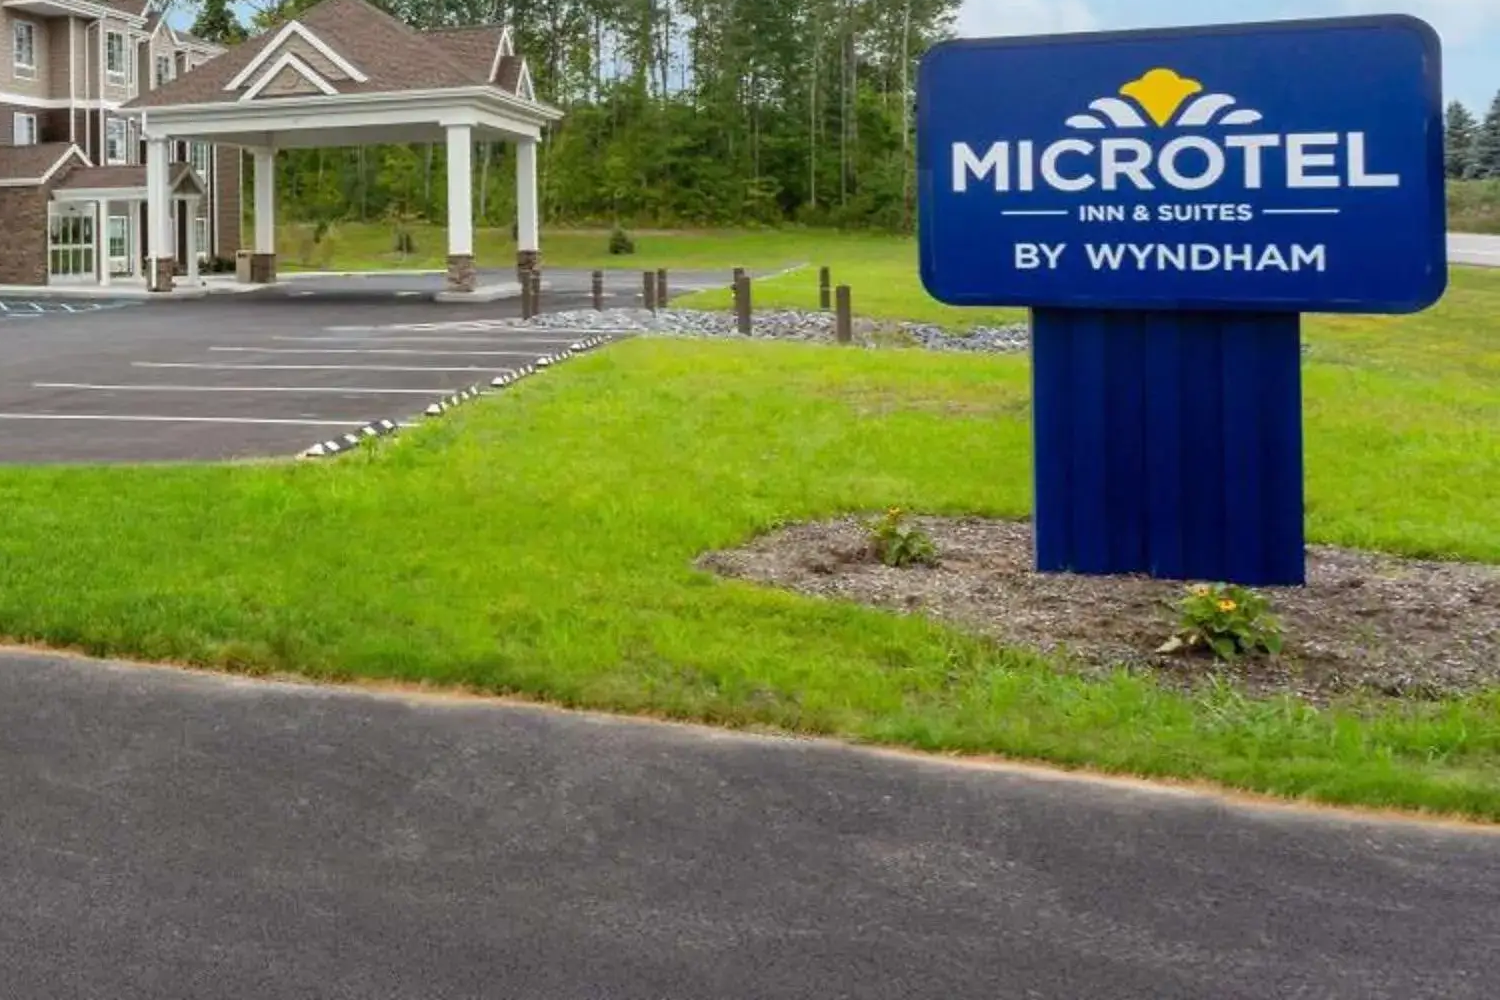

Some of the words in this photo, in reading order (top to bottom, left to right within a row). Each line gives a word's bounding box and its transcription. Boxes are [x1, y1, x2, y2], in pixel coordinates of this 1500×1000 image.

[952, 131, 1399, 192] MICROTEL
[1079, 205, 1125, 222] INN
[1132, 205, 1150, 222] &
[1158, 203, 1253, 221] SUITES
[1015, 243, 1066, 269] BY
[1085, 243, 1326, 271] WYNDHAM
